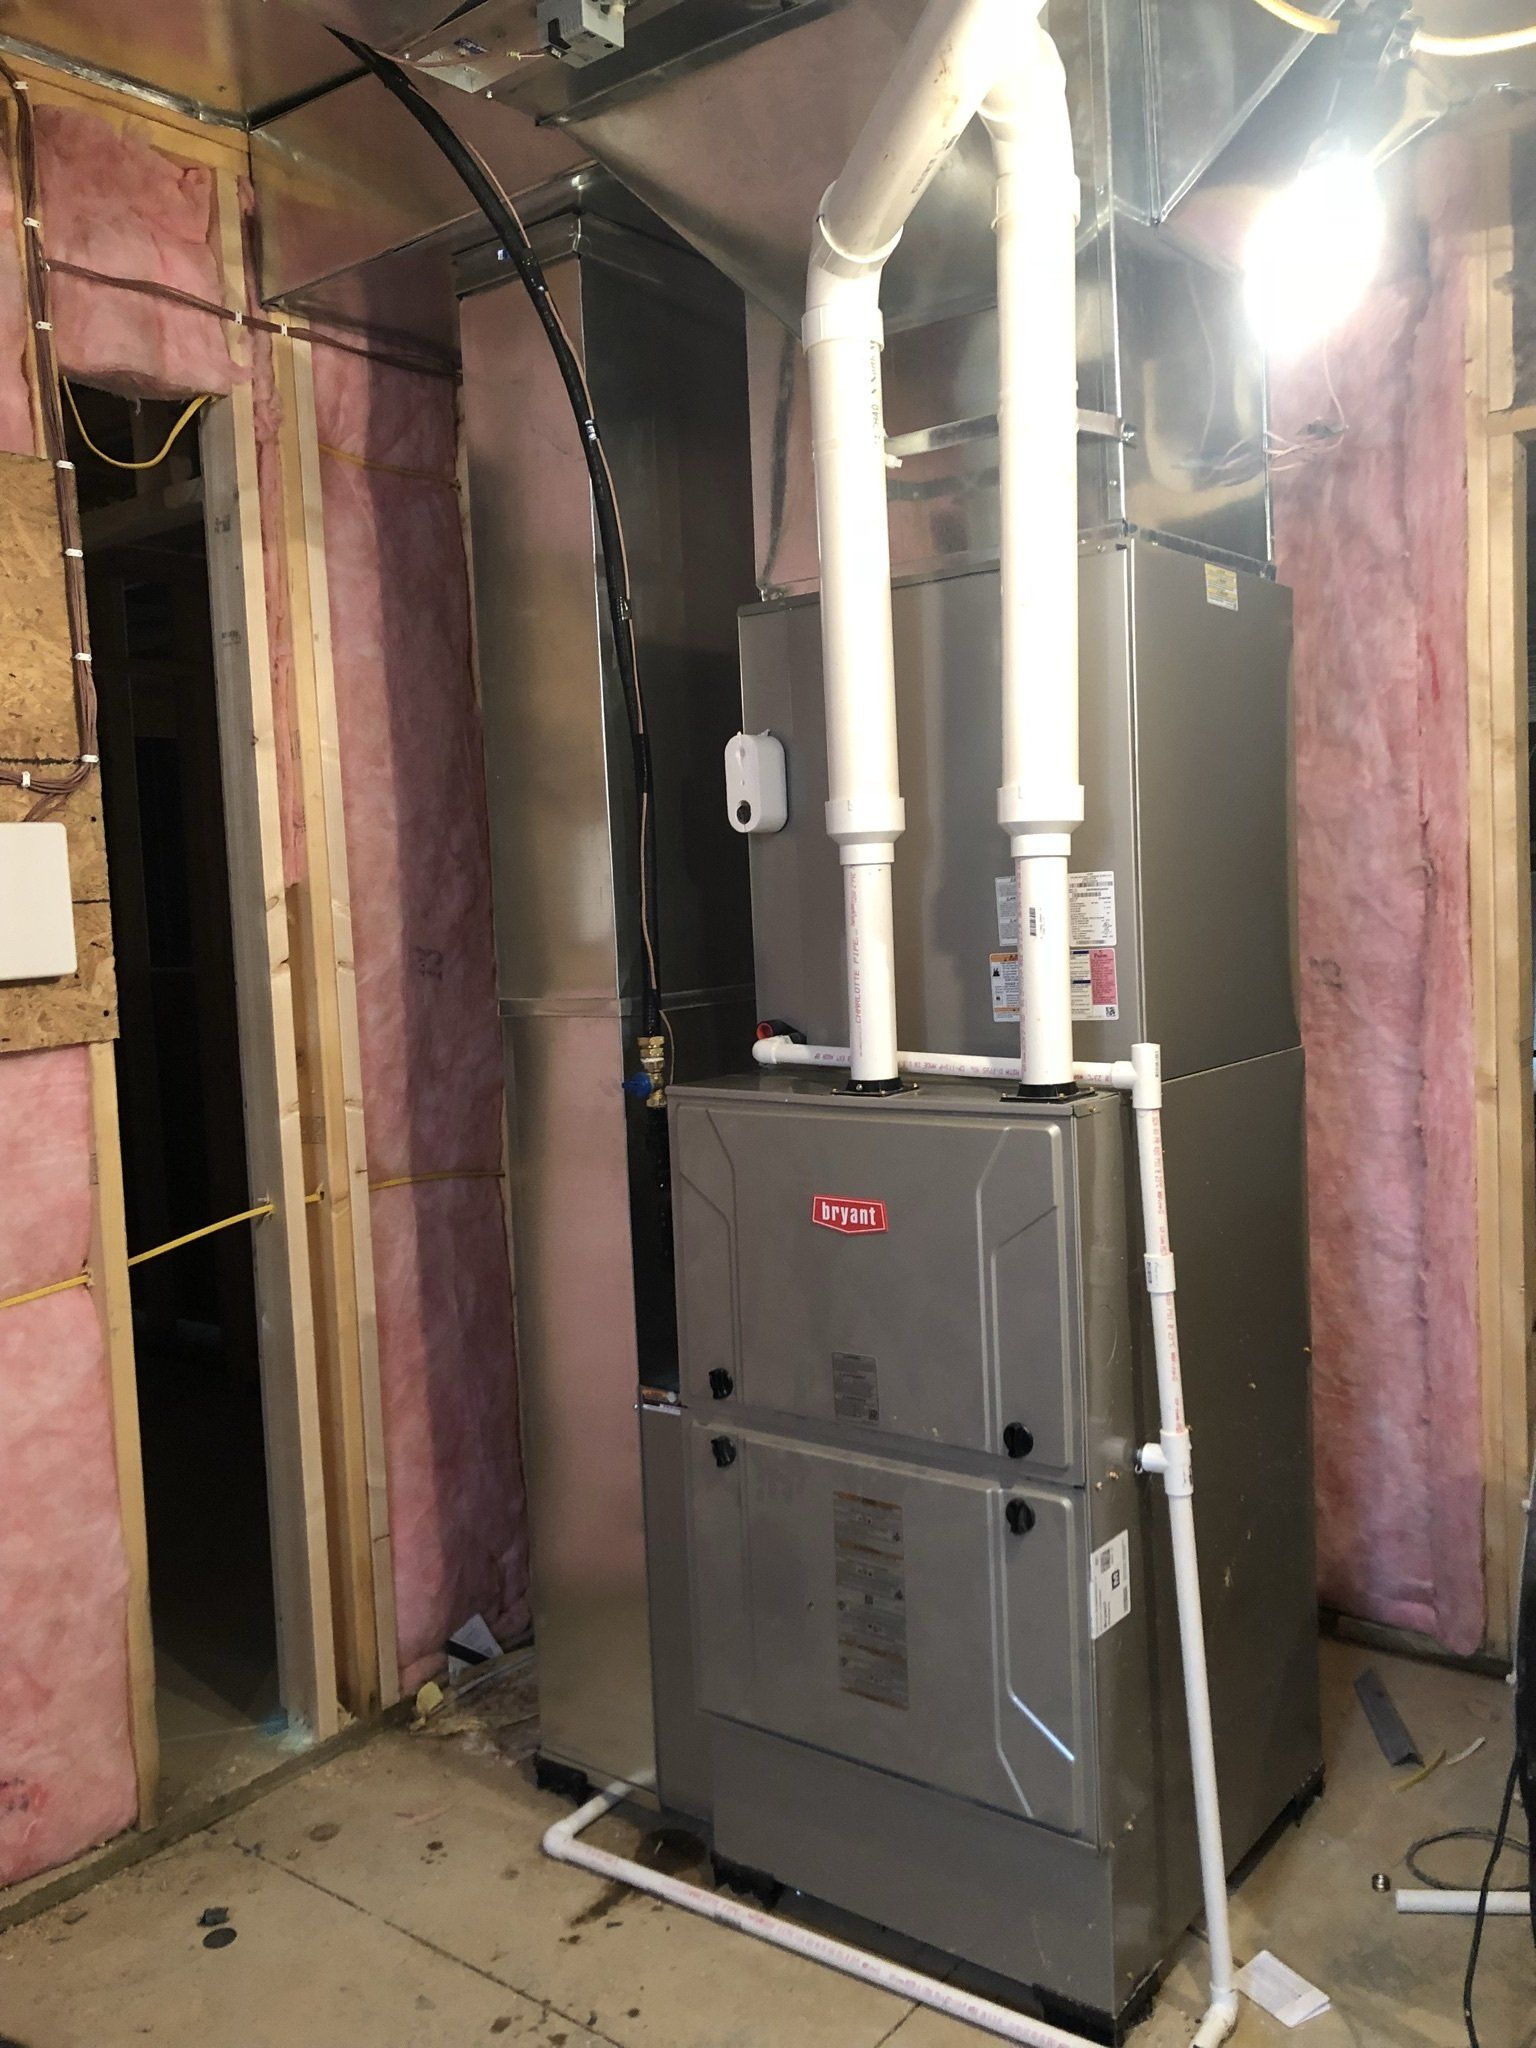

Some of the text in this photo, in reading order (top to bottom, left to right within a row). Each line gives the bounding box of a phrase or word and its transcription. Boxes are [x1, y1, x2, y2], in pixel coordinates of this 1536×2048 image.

[853, 939, 861, 964] PIPE
[854, 969, 862, 1024] CHARLOTTE
[822, 1201, 876, 1225] bryant
